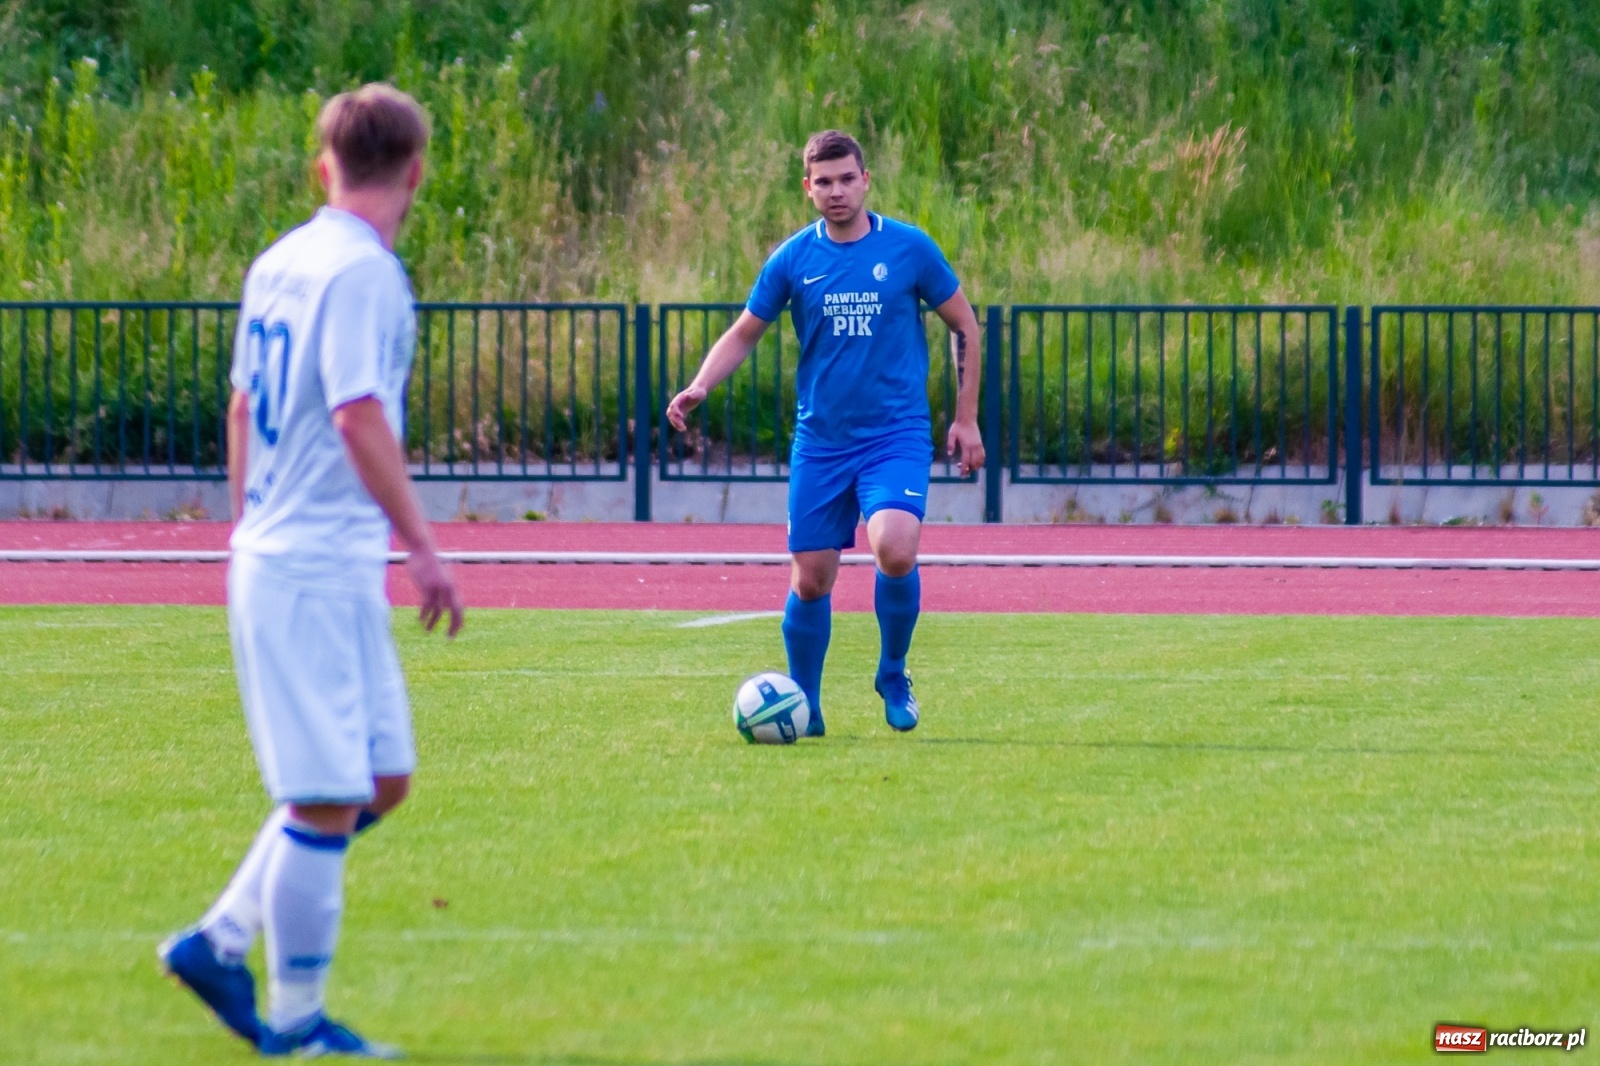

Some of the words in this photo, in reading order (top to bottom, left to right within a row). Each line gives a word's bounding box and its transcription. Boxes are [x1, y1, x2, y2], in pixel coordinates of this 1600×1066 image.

[824, 291, 879, 305] PAWILON
[822, 303, 883, 316] MEBLOWY
[832, 315, 873, 337] PIK
